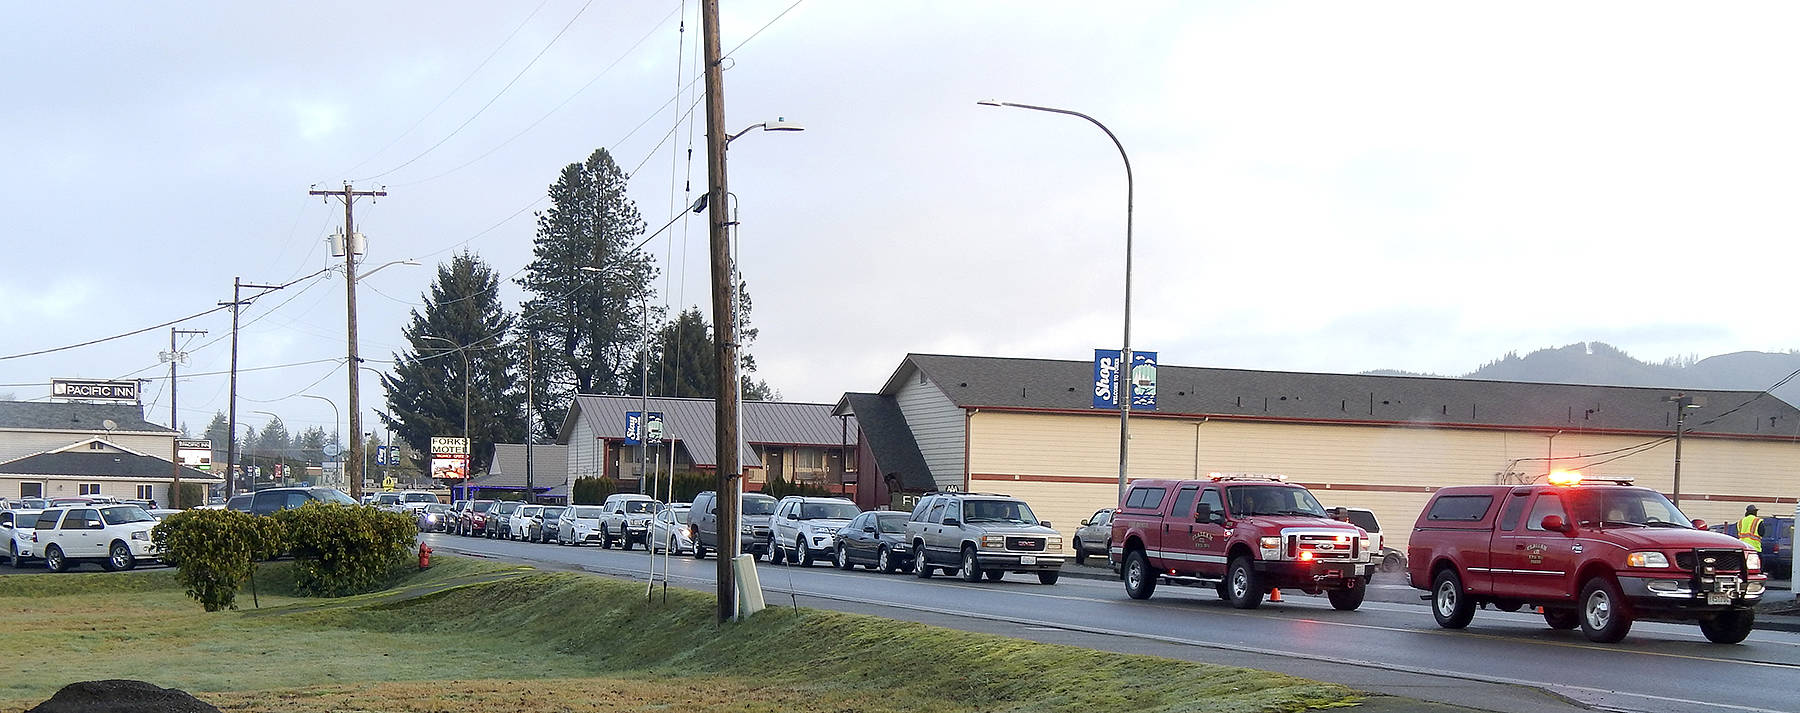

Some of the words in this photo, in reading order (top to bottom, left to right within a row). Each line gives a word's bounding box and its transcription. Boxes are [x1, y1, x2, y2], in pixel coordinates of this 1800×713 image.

[67, 385, 111, 396] PACIFIC
[114, 387, 134, 397] INN
[1095, 358, 1115, 400] Shop
[627, 416, 638, 440] Stay
